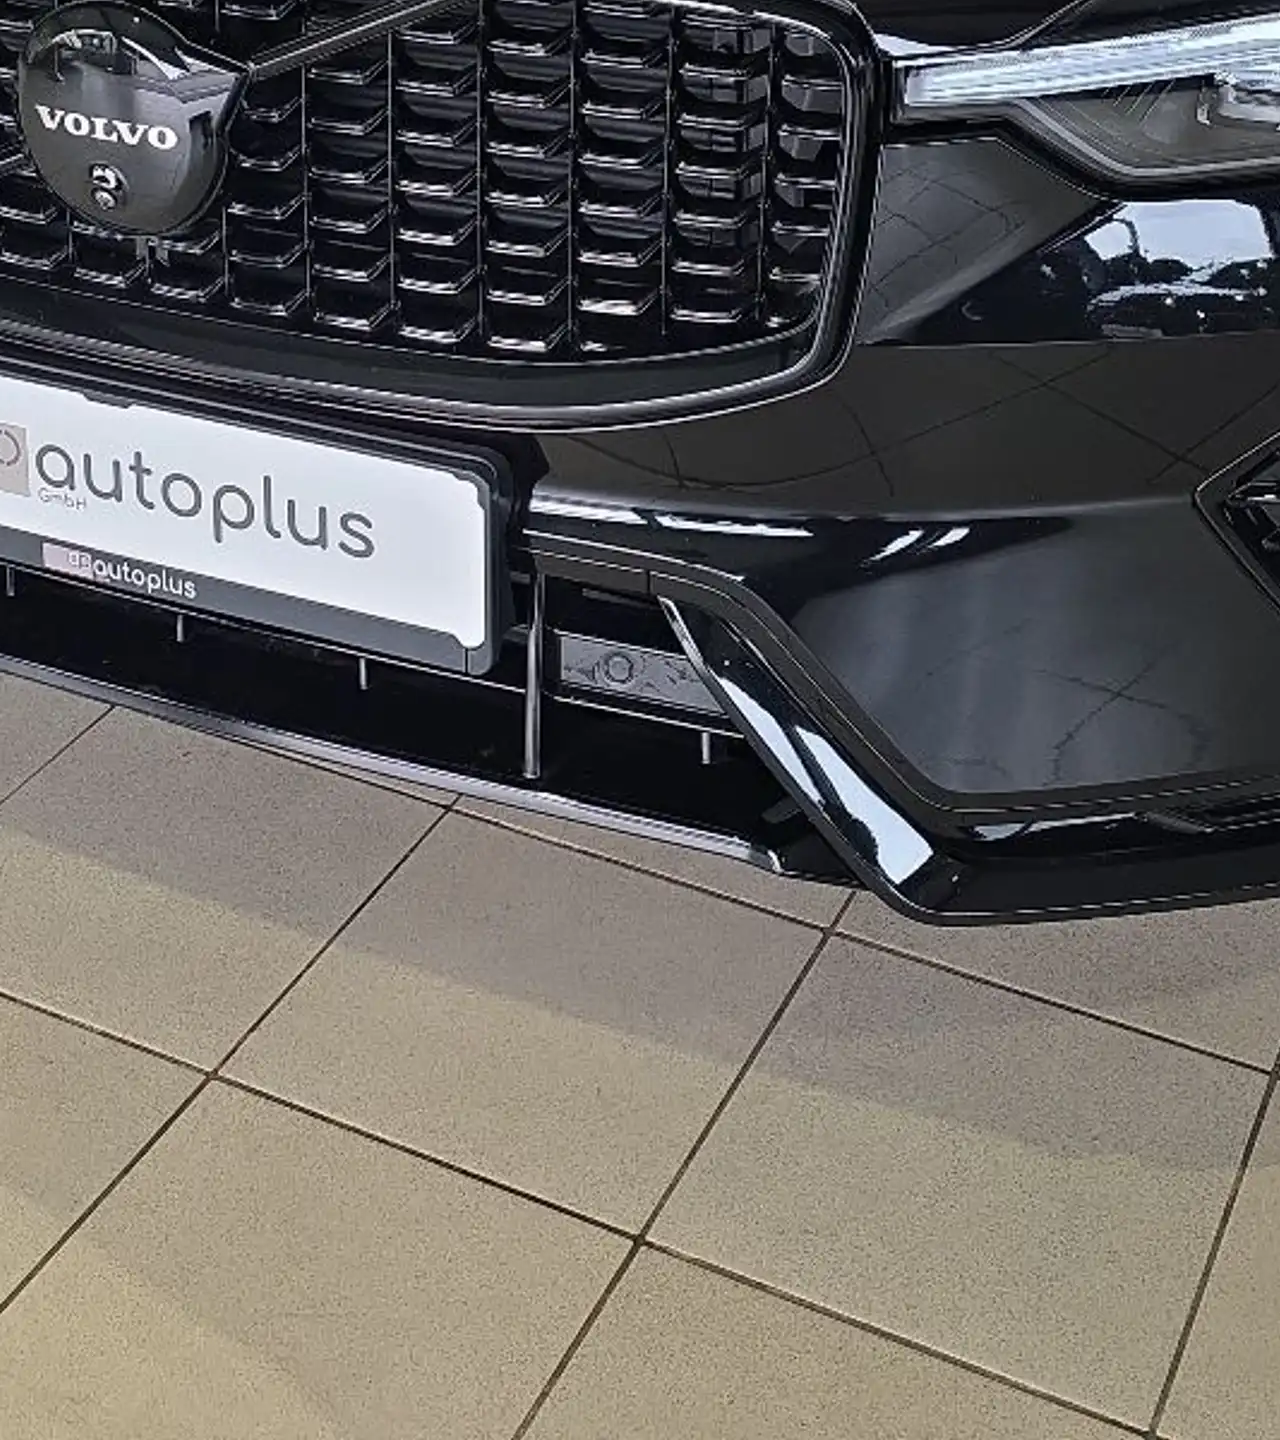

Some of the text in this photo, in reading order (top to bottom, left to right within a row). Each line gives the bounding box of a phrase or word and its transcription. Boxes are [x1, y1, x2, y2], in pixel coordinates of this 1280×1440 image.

[35, 104, 178, 149] VOLVO
[35, 444, 376, 558] autoplus
[38, 487, 87, 510] GmbH
[93, 559, 197, 599] autoplus
